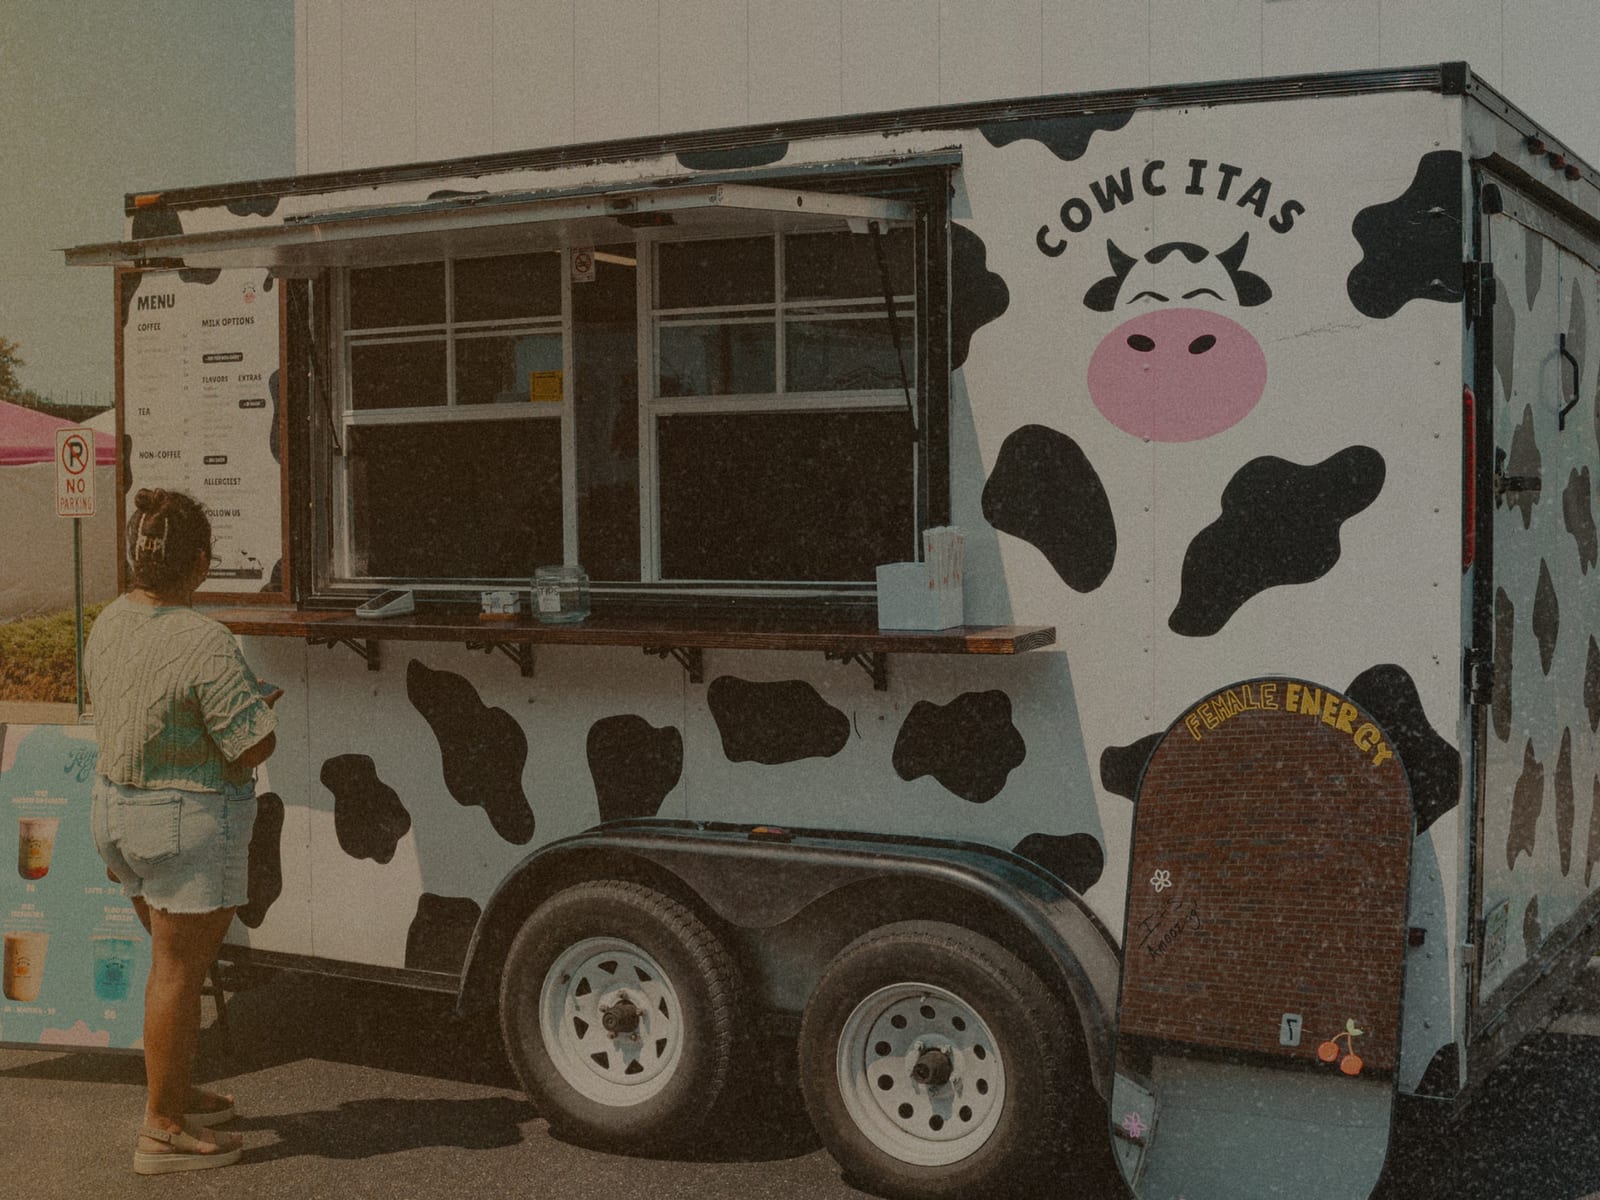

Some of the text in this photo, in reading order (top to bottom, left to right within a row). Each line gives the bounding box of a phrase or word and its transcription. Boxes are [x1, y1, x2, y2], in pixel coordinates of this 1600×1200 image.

[1036, 159, 1306, 258] COWCITAS
[137, 294, 176, 311] MENU
[137, 322, 161, 332] COFFEE
[202, 316, 255, 328] MILK OPTIONS
[202, 375, 229, 383] FLAVORS
[238, 373, 262, 382] EXTRAS
[138, 407, 151, 416] TEA
[139, 450, 181, 459] NON-COFFEE
[66, 478, 85, 494] NO
[60, 496, 92, 511] PARKING
[232, 509, 241, 517] US
[1184, 683, 1394, 766] FEMALE ENERGY
